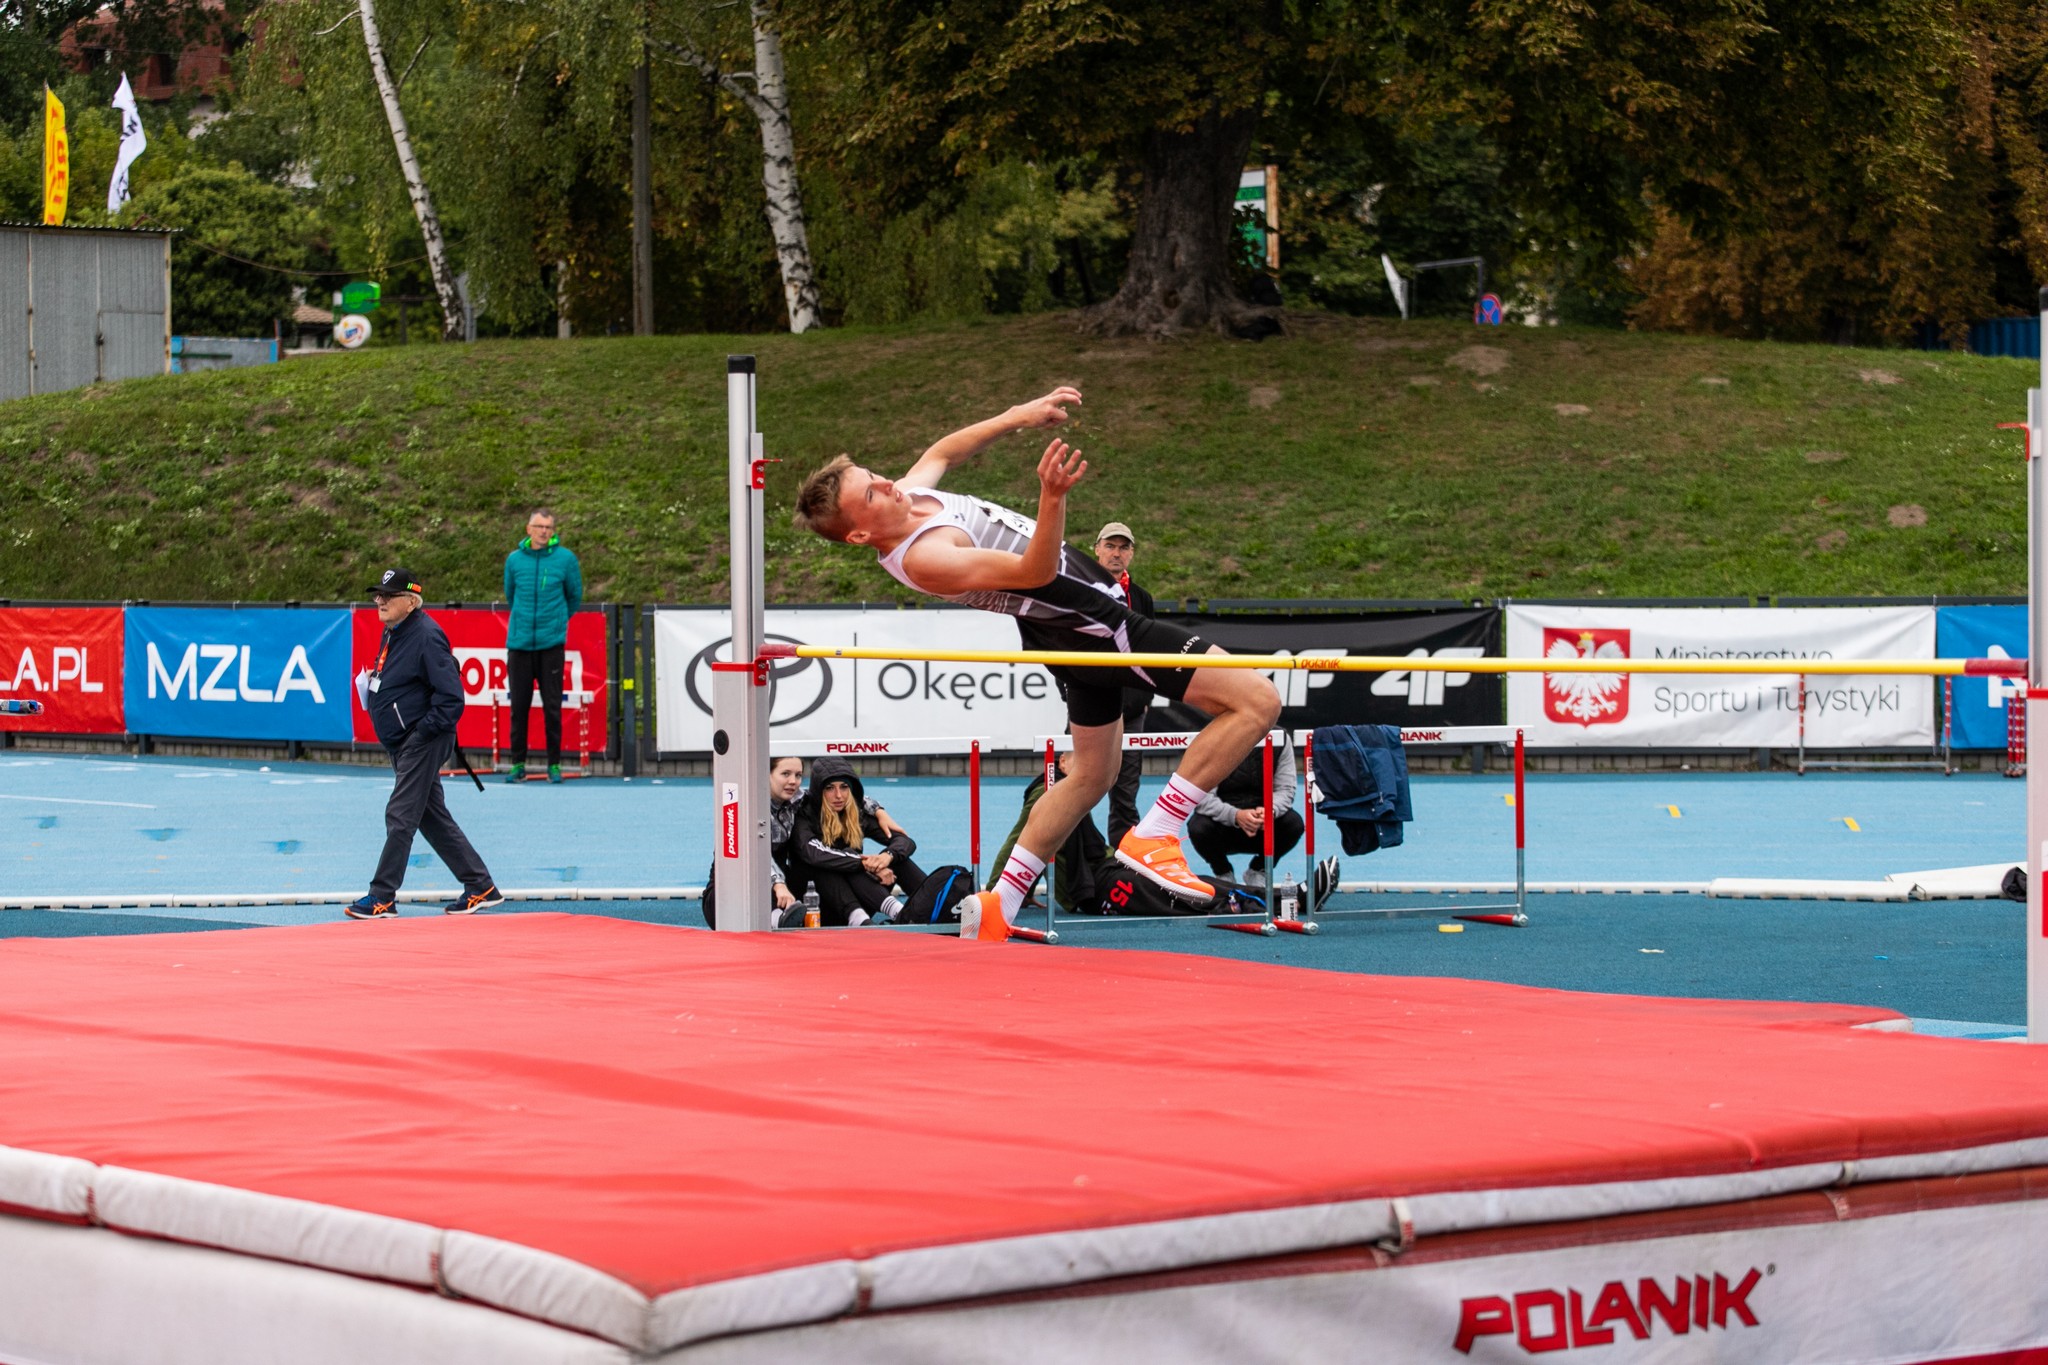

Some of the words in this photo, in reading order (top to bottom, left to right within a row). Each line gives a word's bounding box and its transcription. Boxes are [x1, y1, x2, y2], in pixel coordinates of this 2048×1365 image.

[147, 641, 326, 704] MZLA
[1301, 658, 1341, 669] polanik
[1370, 647, 1485, 706] 4F
[878, 660, 1048, 710] Okęcie
[1655, 686, 1748, 718] Sportu
[1757, 686, 1763, 711] i
[1772, 684, 1901, 717] Turystyki
[826, 742, 890, 754] POLANIK
[1128, 736, 1189, 747] POLANIK
[726, 808, 736, 855] polanik
[1110, 879, 1134, 908] 15
[1453, 1267, 1763, 1354] POLANIK
